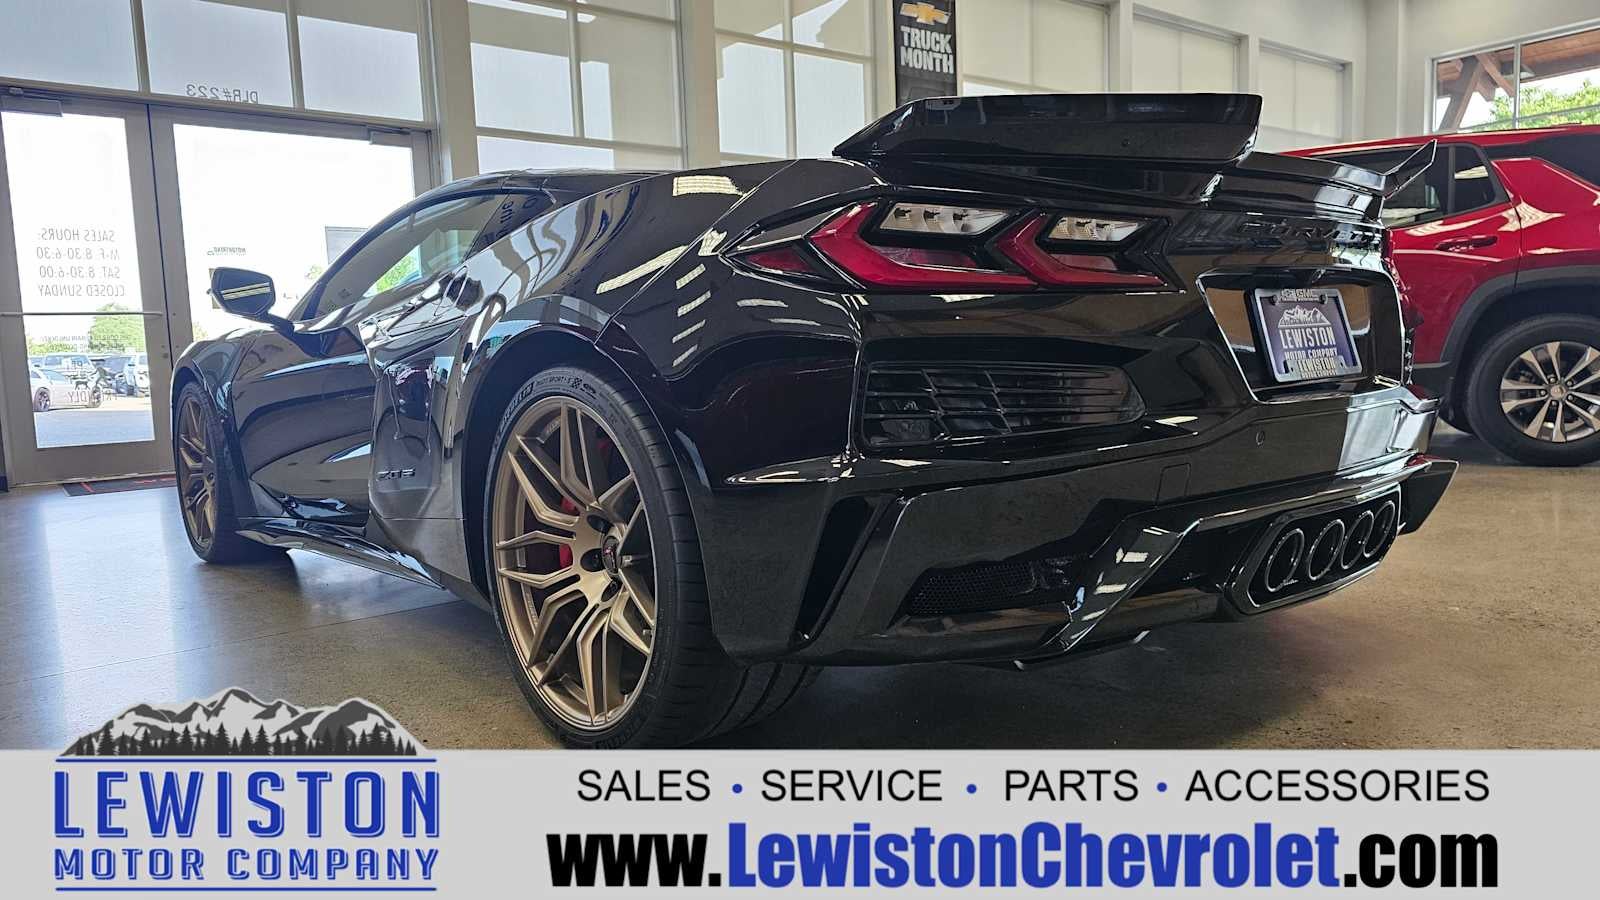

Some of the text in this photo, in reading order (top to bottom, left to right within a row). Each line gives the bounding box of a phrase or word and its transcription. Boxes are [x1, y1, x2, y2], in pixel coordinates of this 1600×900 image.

[900, 25, 952, 53] TRUCK
[900, 46, 954, 74] MONTH
[1279, 326, 1337, 349] LEWISTON
[1284, 347, 1338, 361] MOTOR COMPANY
